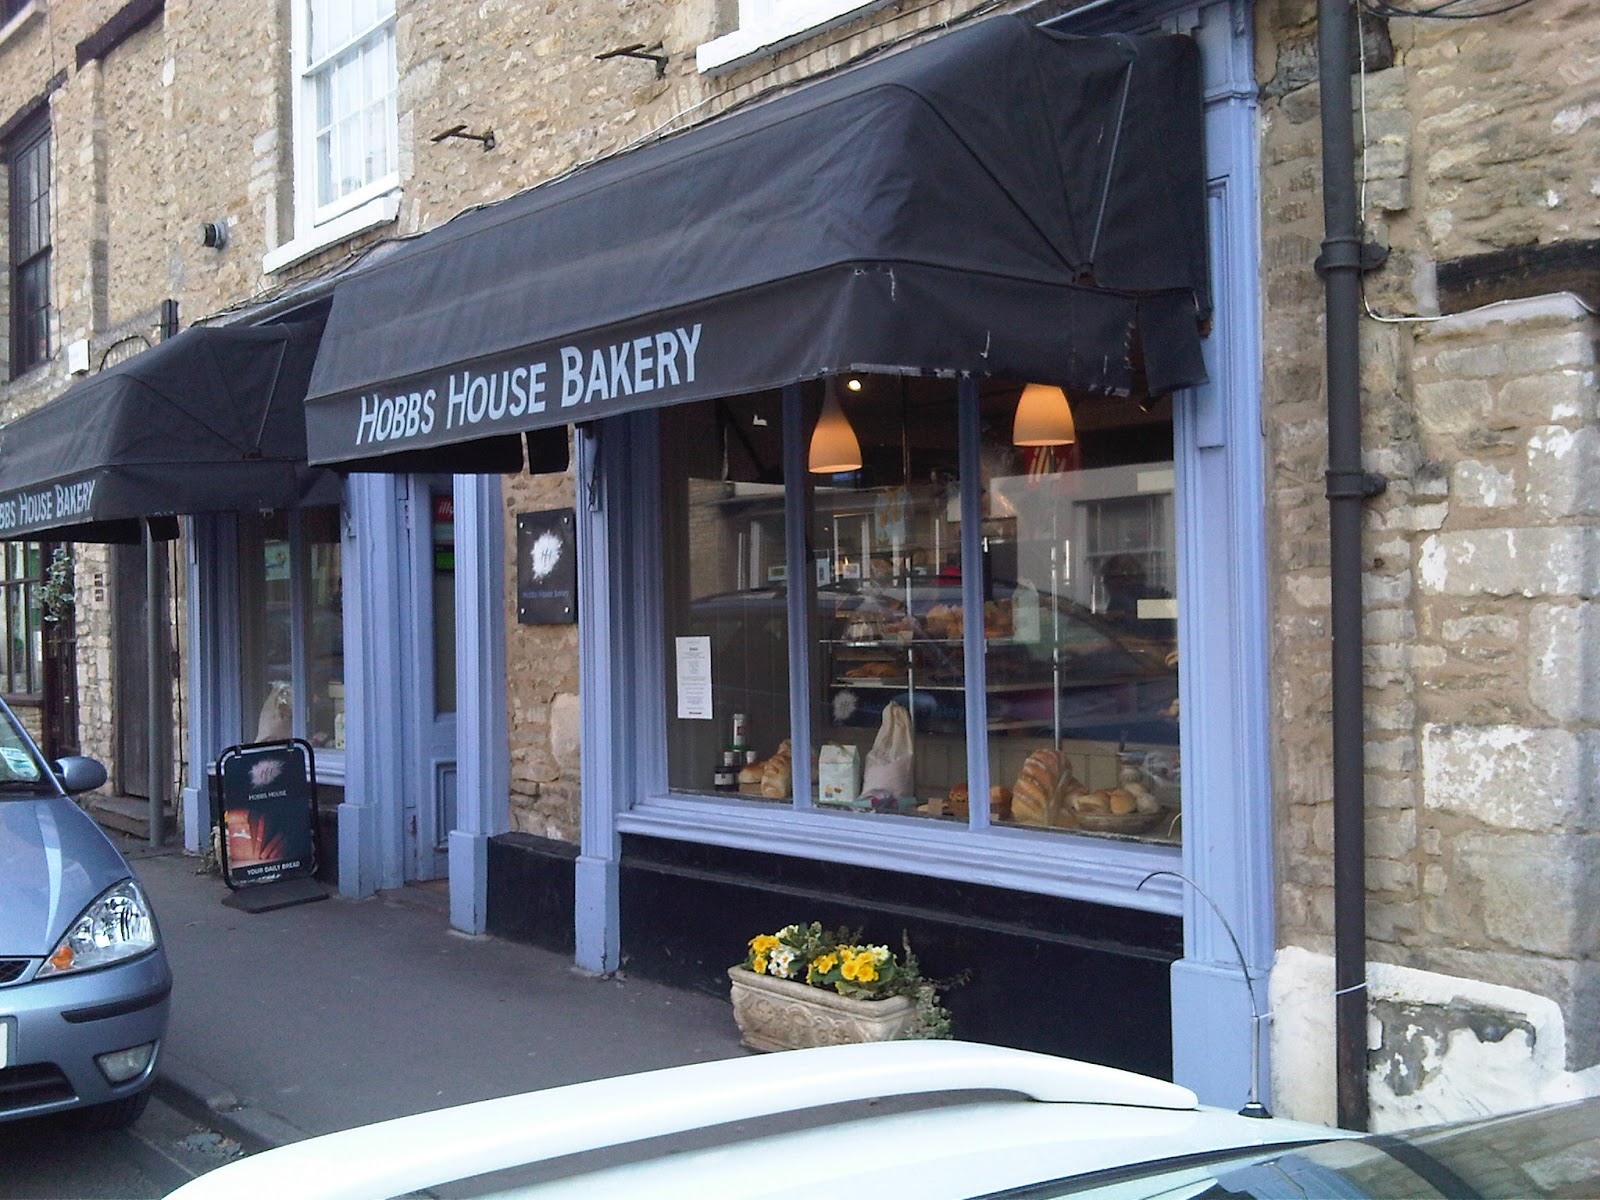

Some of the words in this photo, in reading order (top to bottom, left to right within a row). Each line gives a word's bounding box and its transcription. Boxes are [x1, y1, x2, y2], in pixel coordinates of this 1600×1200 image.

[356, 390, 436, 445] HOBBS
[447, 363, 547, 429] HOUSE
[561, 324, 702, 408] BAKERY
[0, 501, 16, 529] BBS
[19, 492, 52, 525] HOUSE
[54, 480, 96, 517] BAKERY
[247, 868, 264, 876] YOUR
[264, 864, 281, 873] DAILY
[282, 861, 300, 869] BREAD
